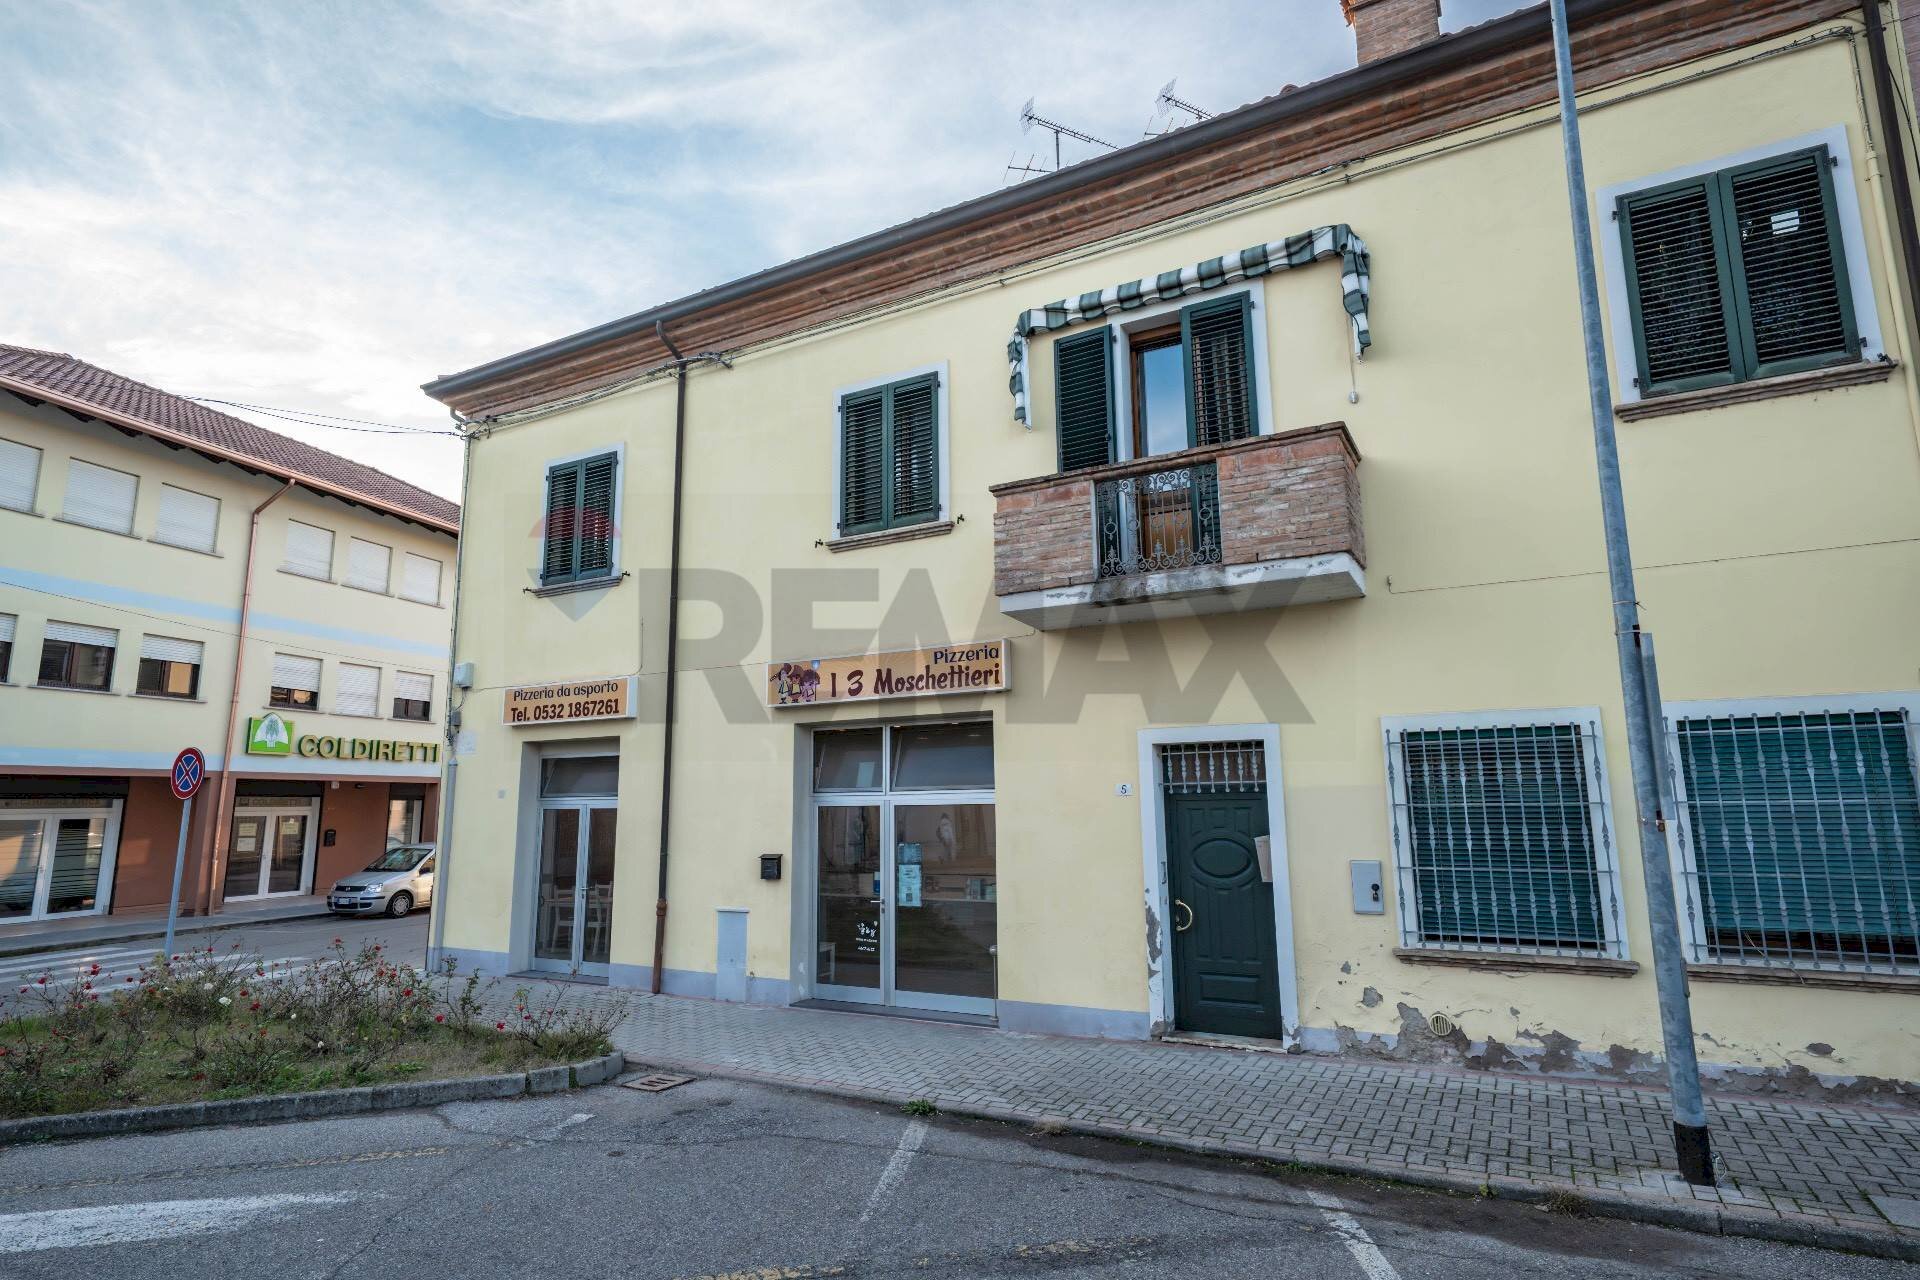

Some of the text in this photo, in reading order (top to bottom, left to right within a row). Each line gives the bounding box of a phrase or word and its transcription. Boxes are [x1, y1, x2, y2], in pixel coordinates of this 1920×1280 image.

[934, 645, 999, 664] Pizzeria
[847, 669, 863, 696] 3
[873, 663, 1000, 695] Moschettieri
[513, 681, 618, 701] Pizzeria da asporto
[511, 698, 620, 722] Tel. 0532 1867261
[299, 735, 440, 762] COLDIRETTI
[1120, 784, 1127, 795] 5
